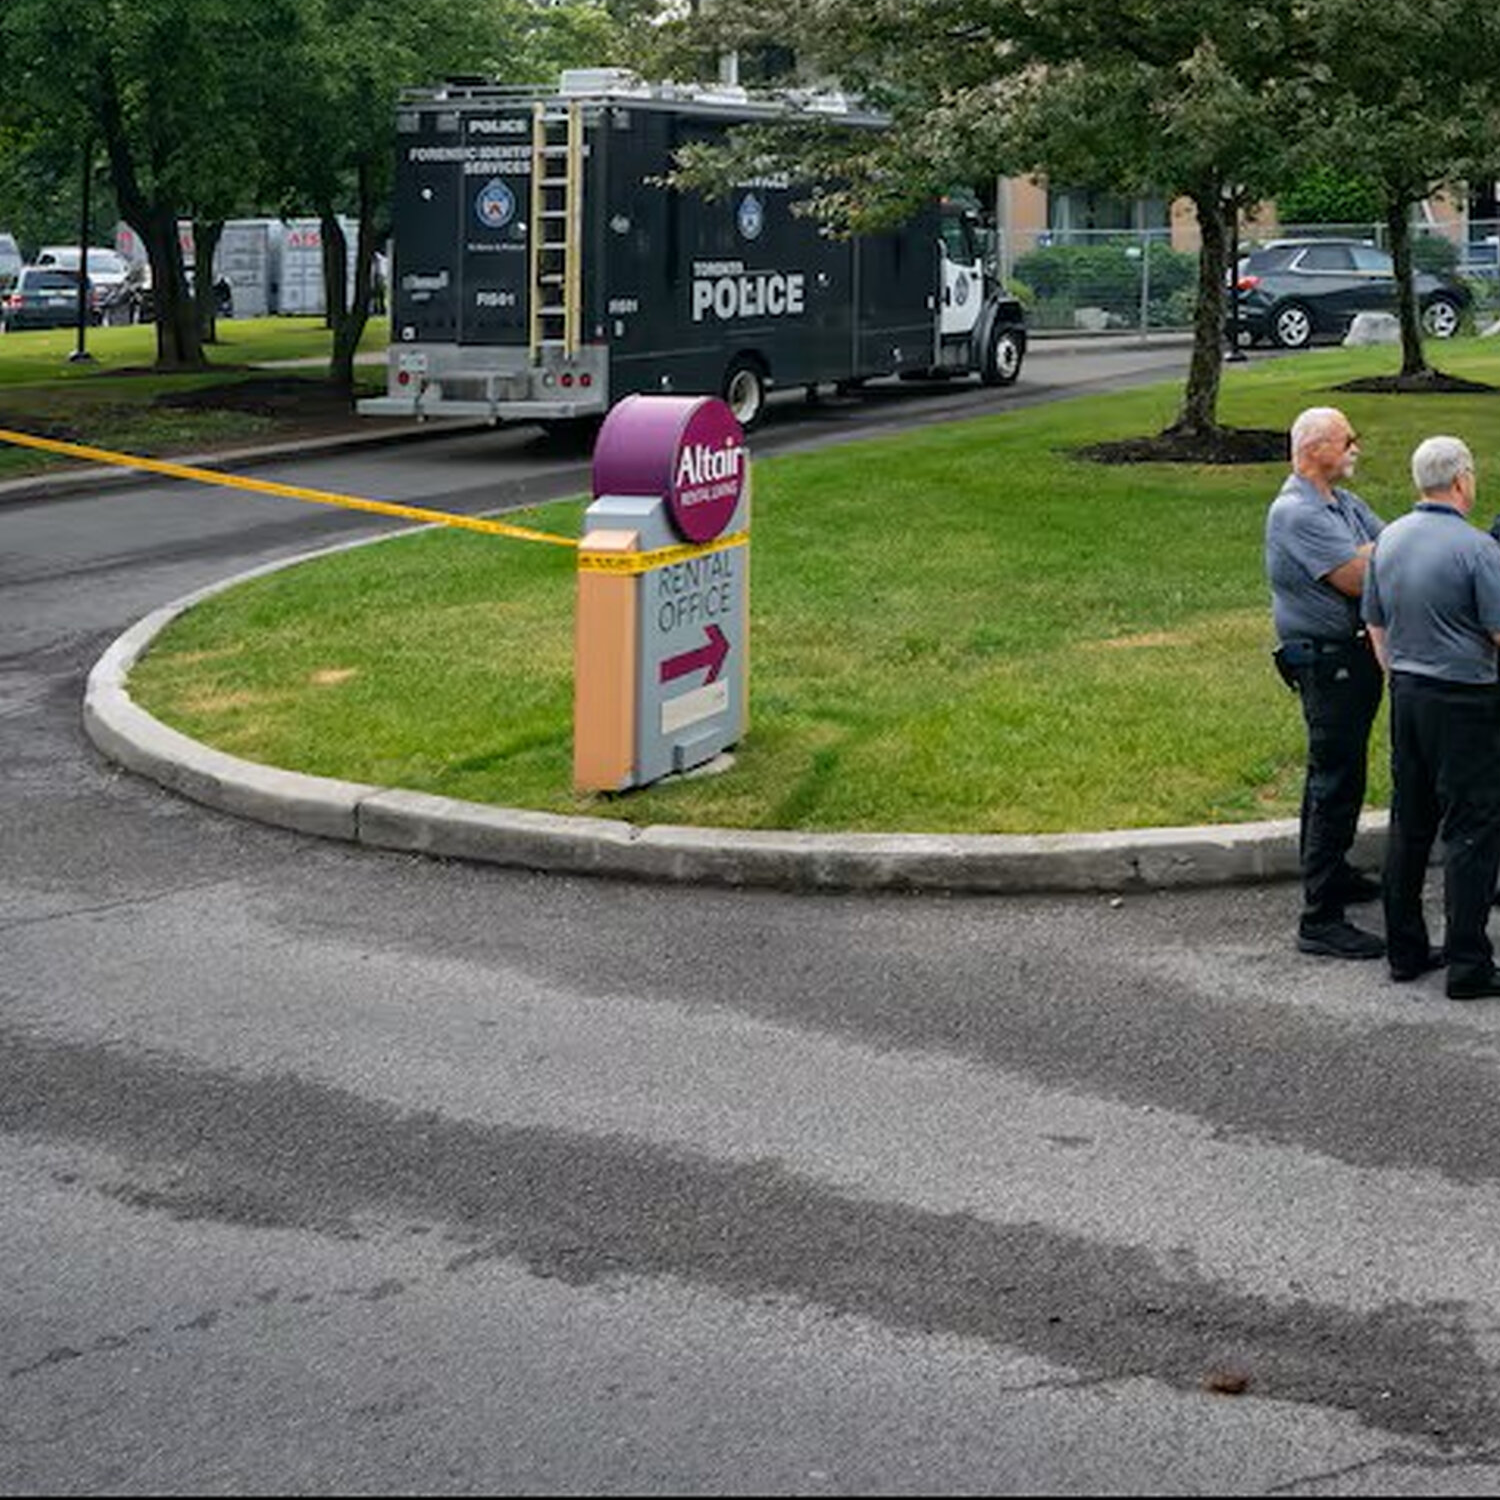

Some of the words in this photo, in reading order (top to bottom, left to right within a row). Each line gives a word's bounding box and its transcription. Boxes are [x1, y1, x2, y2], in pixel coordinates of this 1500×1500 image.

[468, 119, 528, 134] POLICE
[409, 148, 476, 162] FORENSIC
[463, 161, 532, 175] SERVICES
[692, 273, 805, 322] POLICE
[676, 436, 745, 488] Altair
[658, 552, 733, 597] RENTAL
[658, 582, 732, 633] OFFICE
